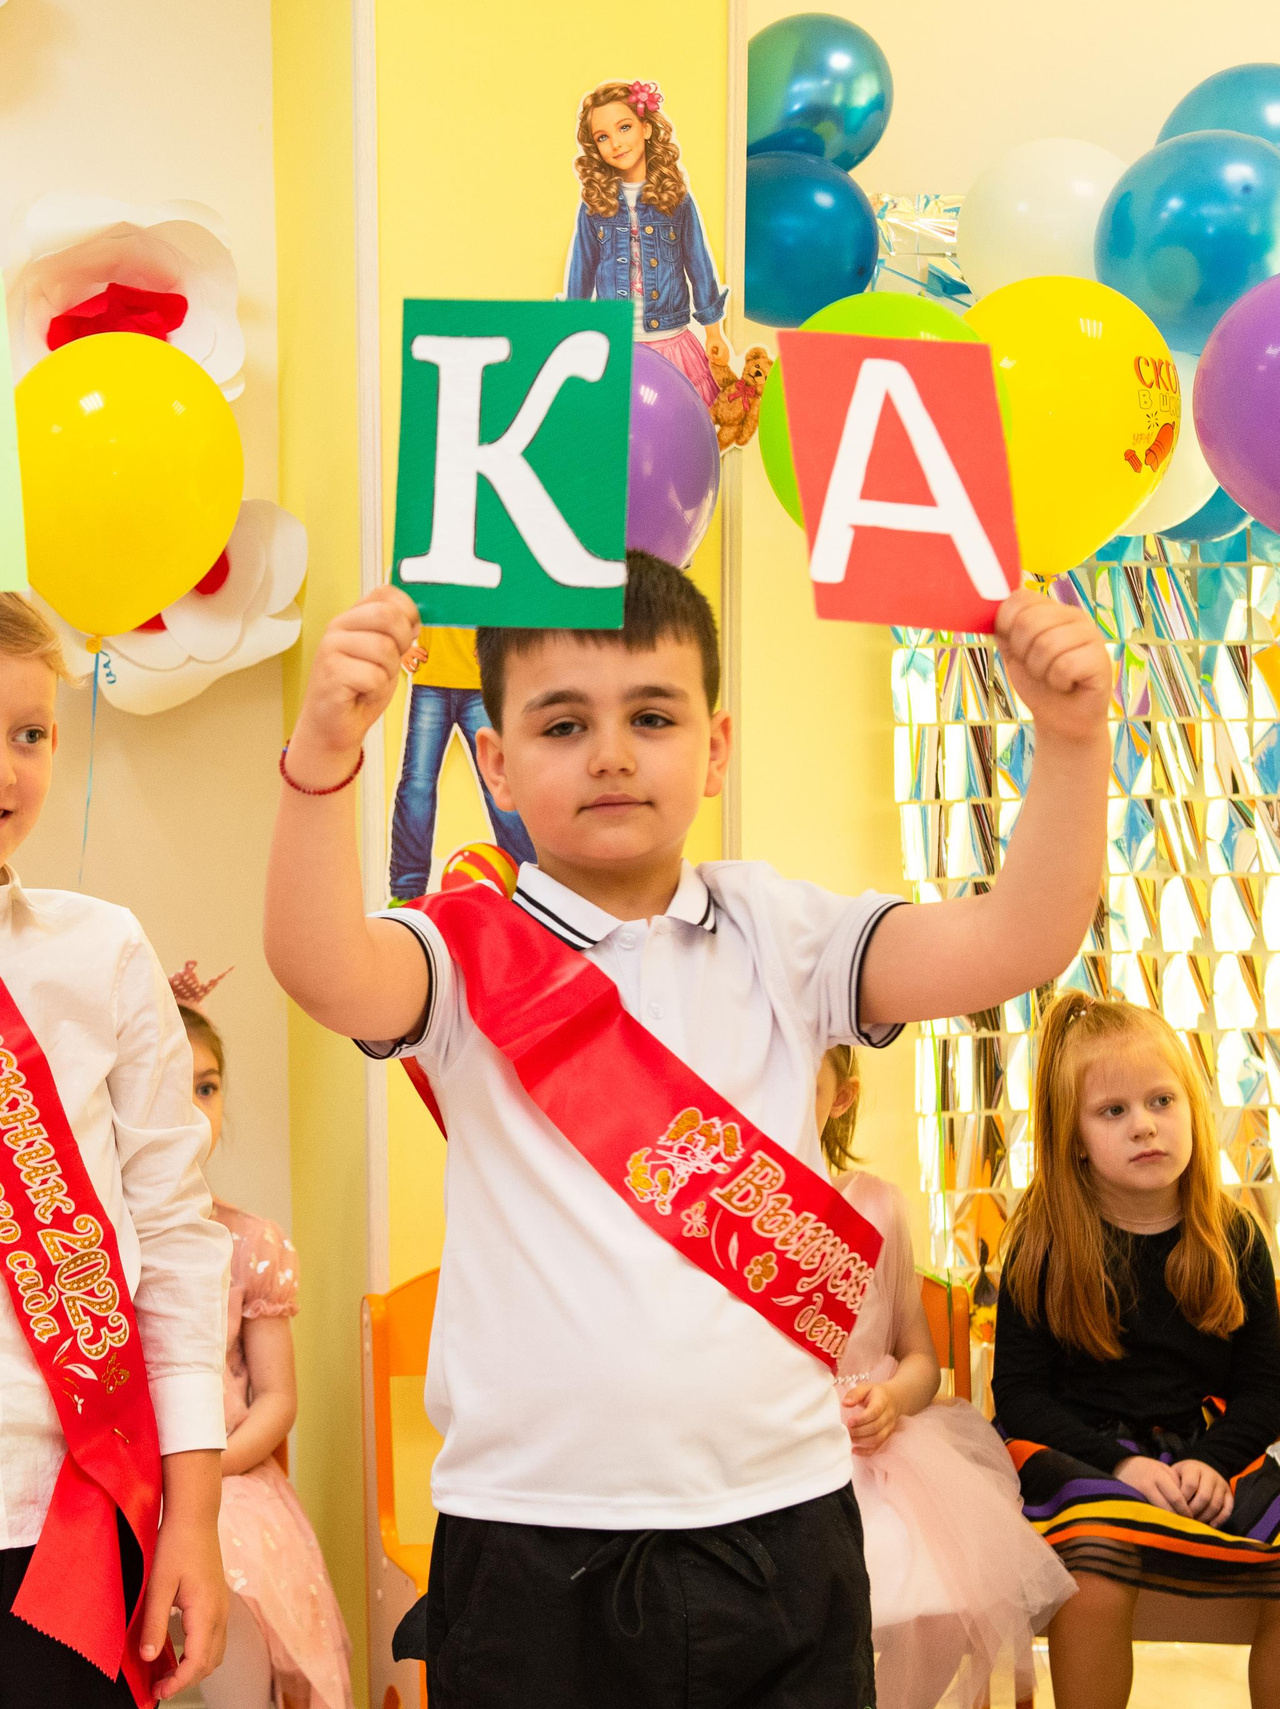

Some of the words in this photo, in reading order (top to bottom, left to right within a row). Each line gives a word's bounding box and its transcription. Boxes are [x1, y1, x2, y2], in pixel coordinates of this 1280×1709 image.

[1133, 356, 1180, 394] СКО
[1138, 389, 1153, 410] В
[6, 1251, 60, 1344] сада
[38, 1214, 130, 1361] 2023
